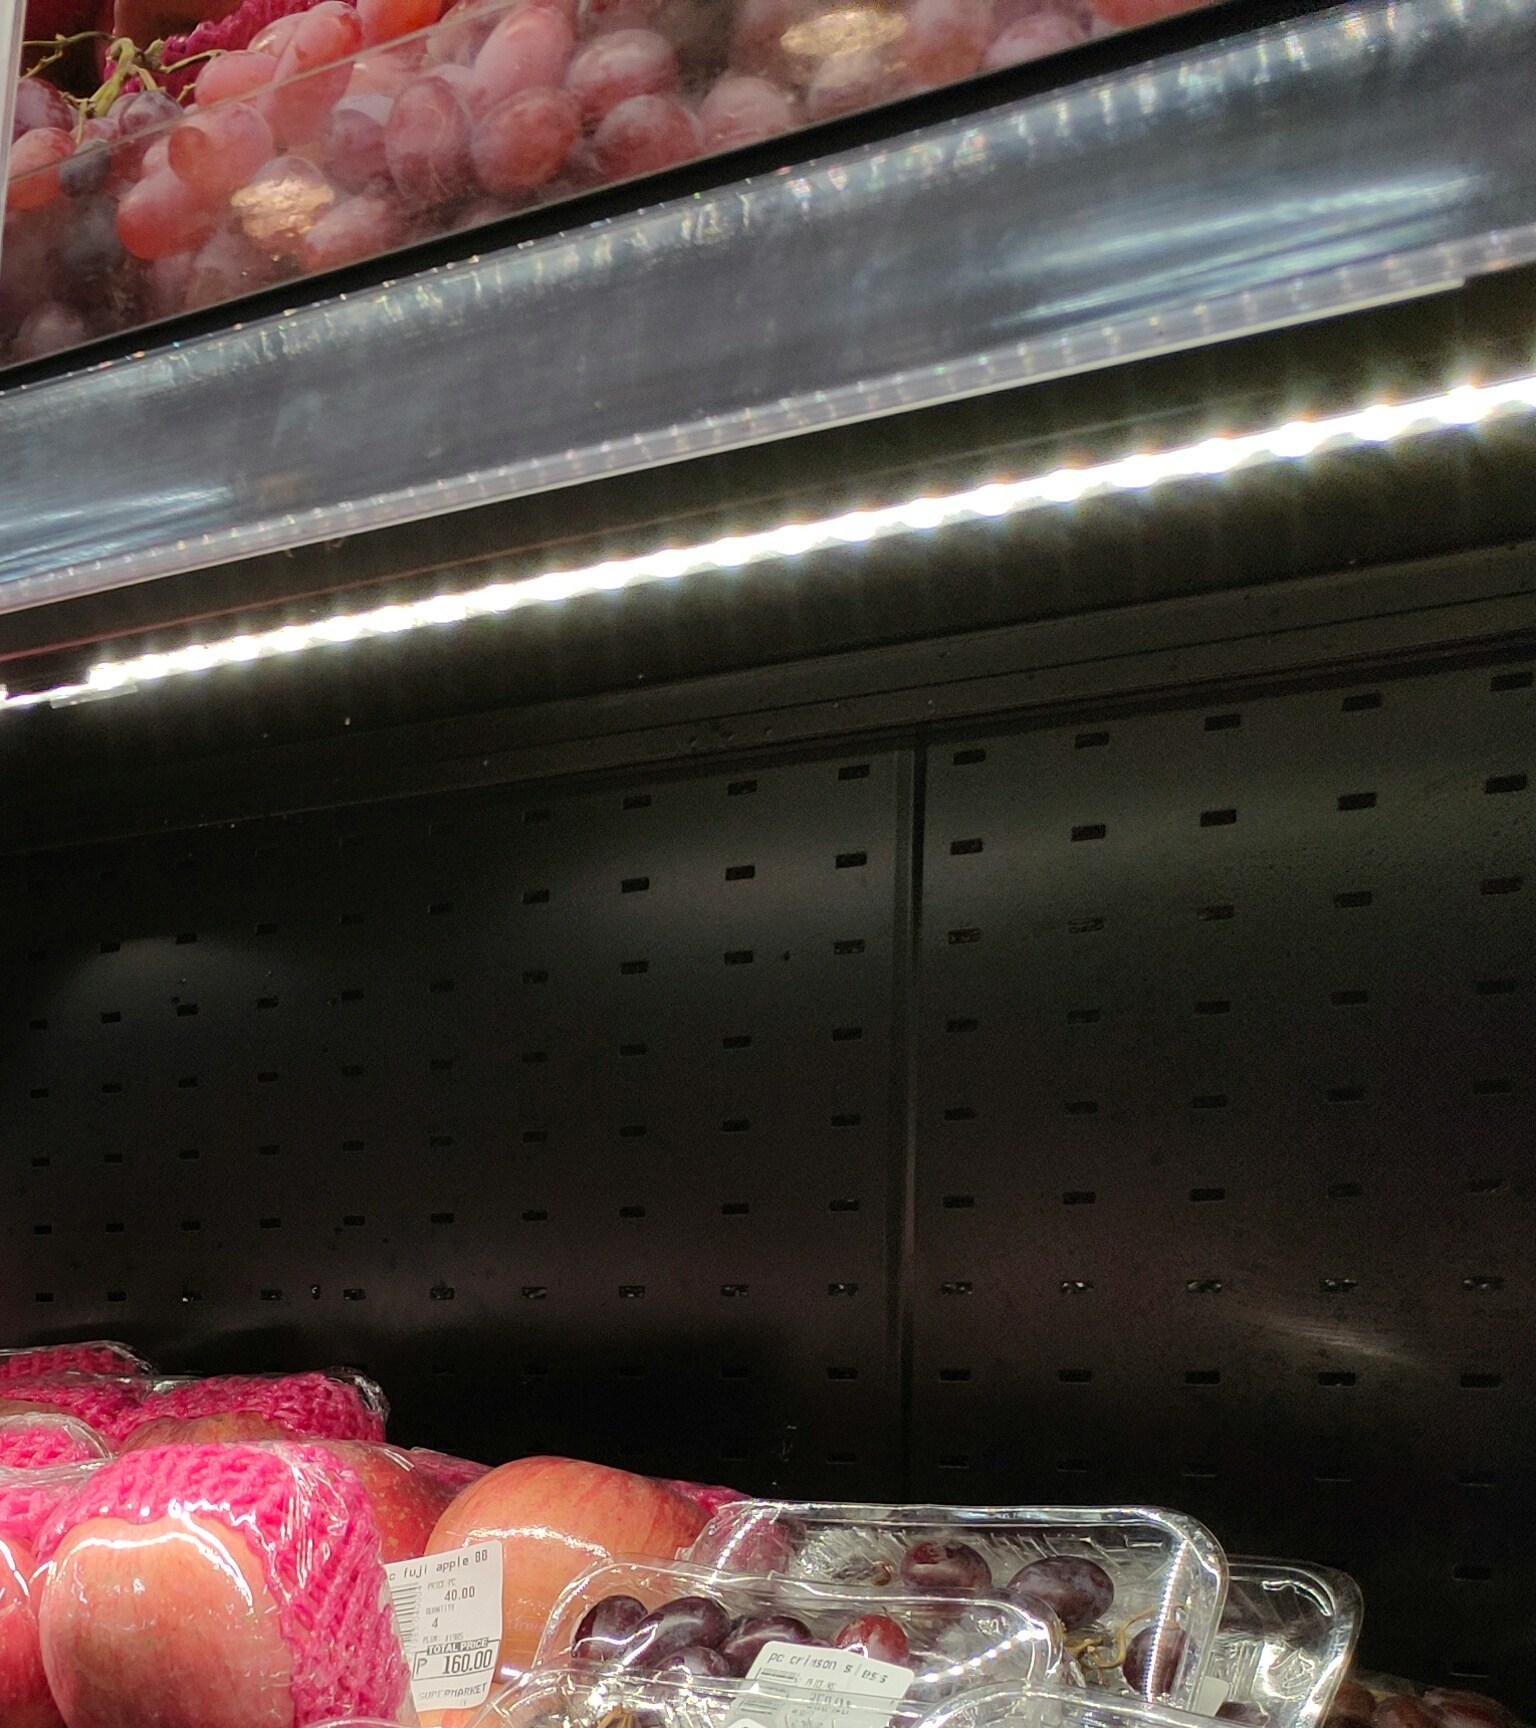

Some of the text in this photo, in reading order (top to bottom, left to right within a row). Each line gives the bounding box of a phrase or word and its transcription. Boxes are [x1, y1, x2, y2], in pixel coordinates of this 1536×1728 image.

[404, 1566, 428, 1579] fuji
[436, 1556, 470, 1574] apple
[444, 1586, 476, 1601] 40.00
[431, 1617, 439, 1628] 4
[427, 1639, 489, 1655] TOTAL PRICE
[443, 1649, 493, 1675] 160.00
[767, 1652, 784, 1664] pc
[418, 1682, 488, 1700] SUPERMARKET
